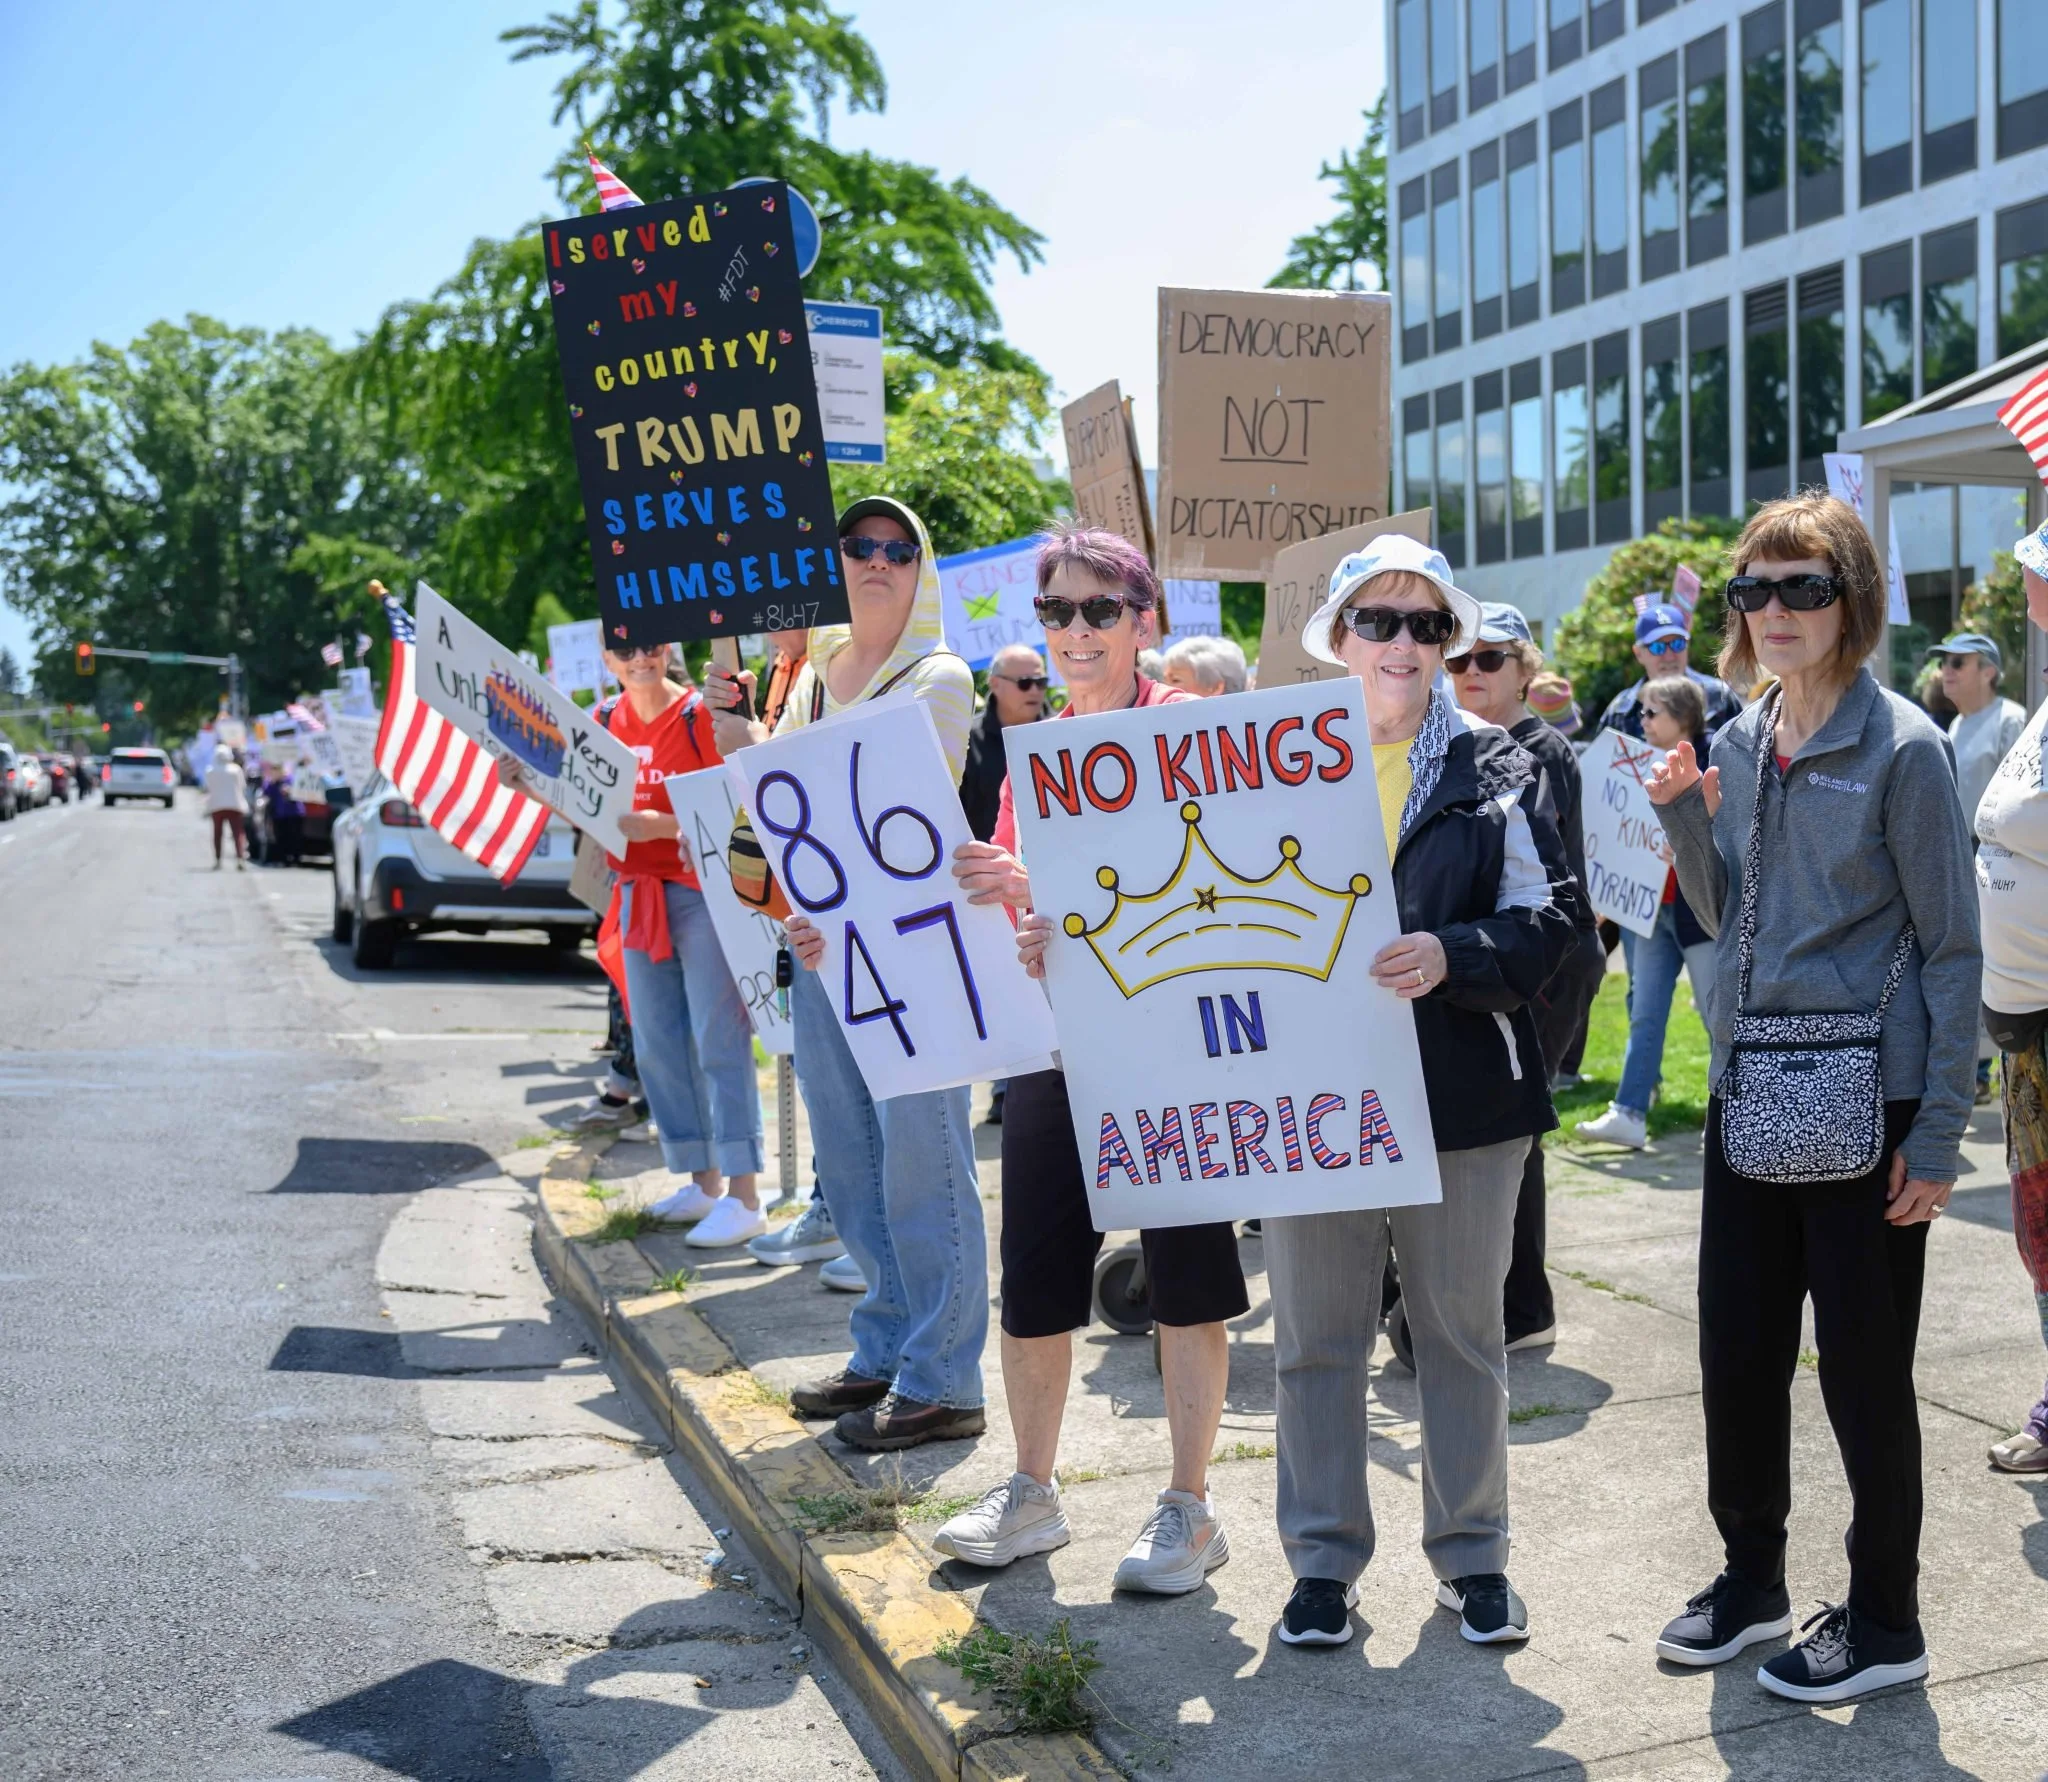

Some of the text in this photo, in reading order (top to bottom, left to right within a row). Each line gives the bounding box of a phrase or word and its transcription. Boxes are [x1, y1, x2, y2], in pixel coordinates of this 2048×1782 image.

[567, 204, 711, 263] served
[619, 280, 679, 323] my
[718, 244, 749, 302] #FDT
[595, 329, 778, 392] country,
[1179, 310, 1375, 359] DEMOCRACY
[595, 402, 802, 472] TRUMP
[1224, 396, 1325, 458] NOT
[602, 481, 787, 535] SERVES
[615, 547, 839, 609] HIMSELF!
[955, 557, 1036, 595] KING
[752, 601, 820, 631] #8647
[438, 616, 619, 787] A Very
[1029, 708, 1353, 819] NO KINGS
[1847, 780, 1869, 793] LAW
[1601, 777, 1628, 813] NO
[755, 741, 943, 914] 86
[1590, 861, 1658, 921] TYRANTS
[843, 900, 988, 1058] 47
[1197, 991, 1268, 1058] IN
[1096, 1089, 1403, 1189] AMERICA
